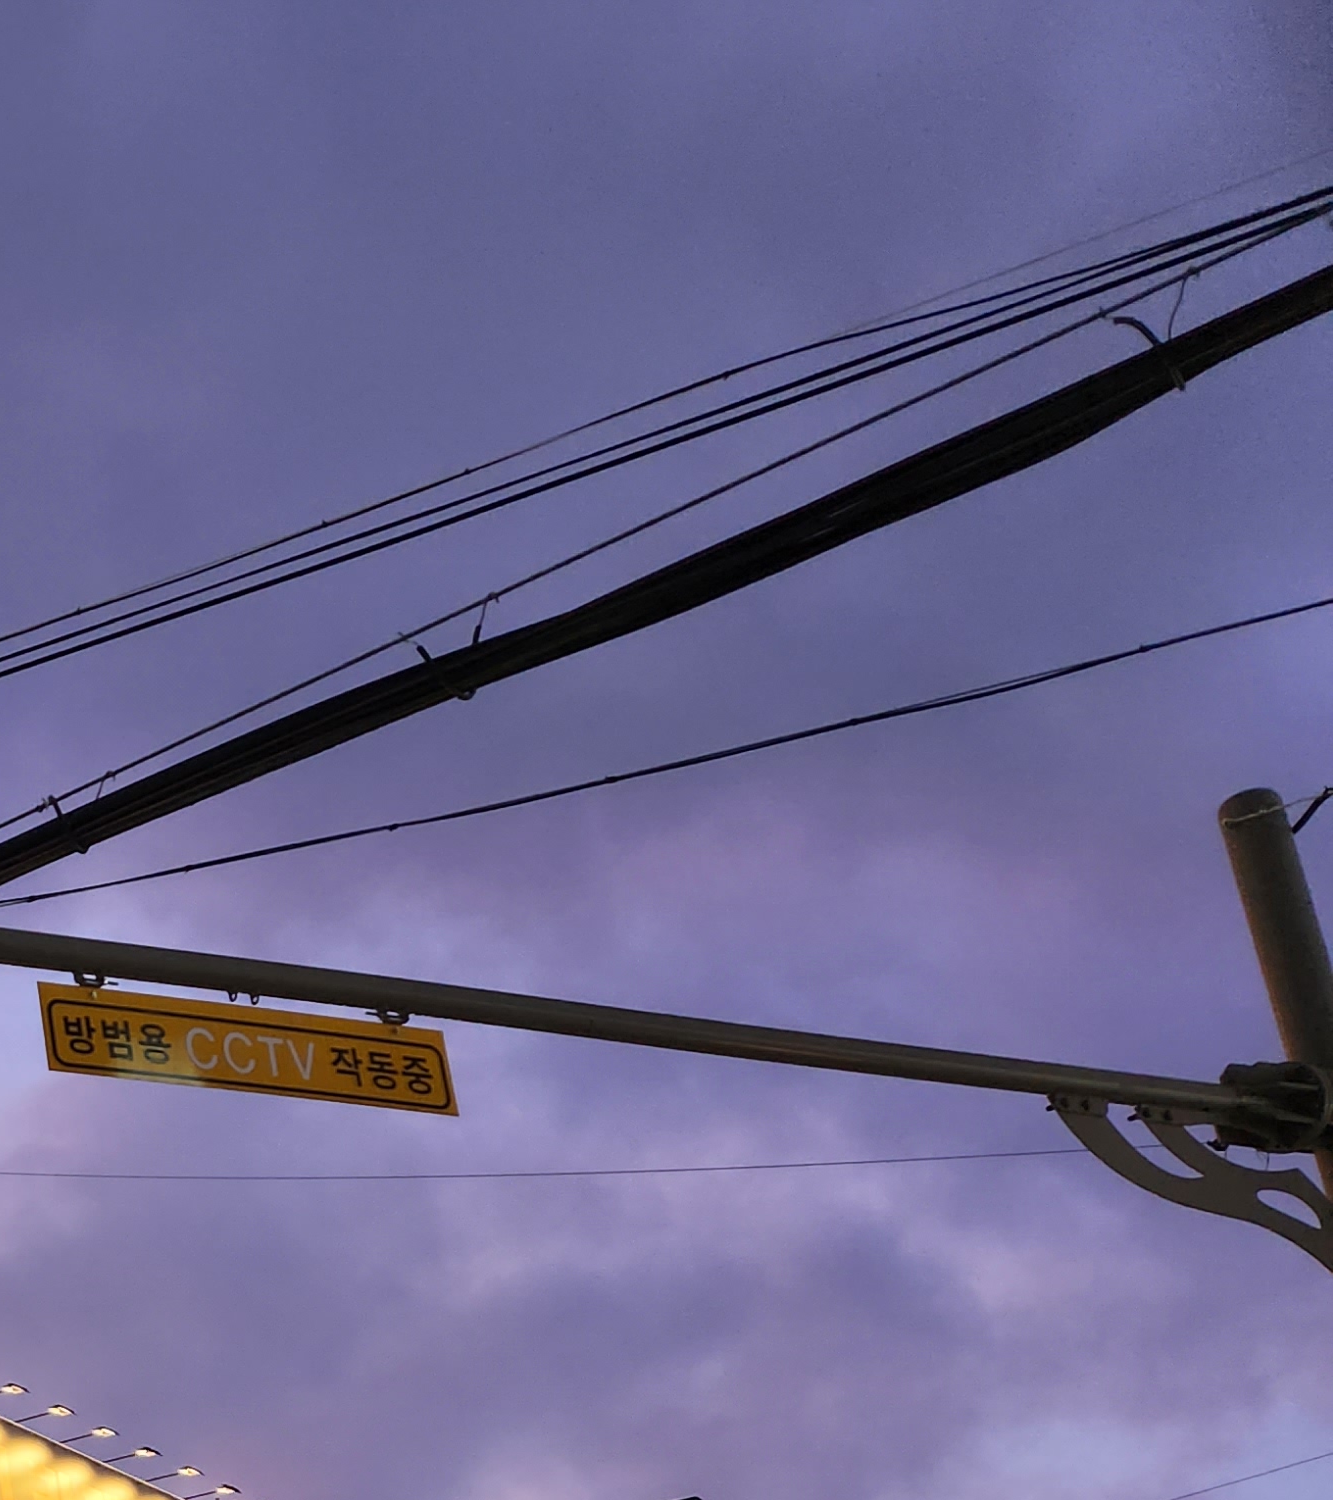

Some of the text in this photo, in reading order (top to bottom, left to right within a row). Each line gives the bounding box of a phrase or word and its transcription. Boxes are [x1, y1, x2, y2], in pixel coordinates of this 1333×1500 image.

[63, 1014, 432, 1095] 방범용 CCTV 작동중
